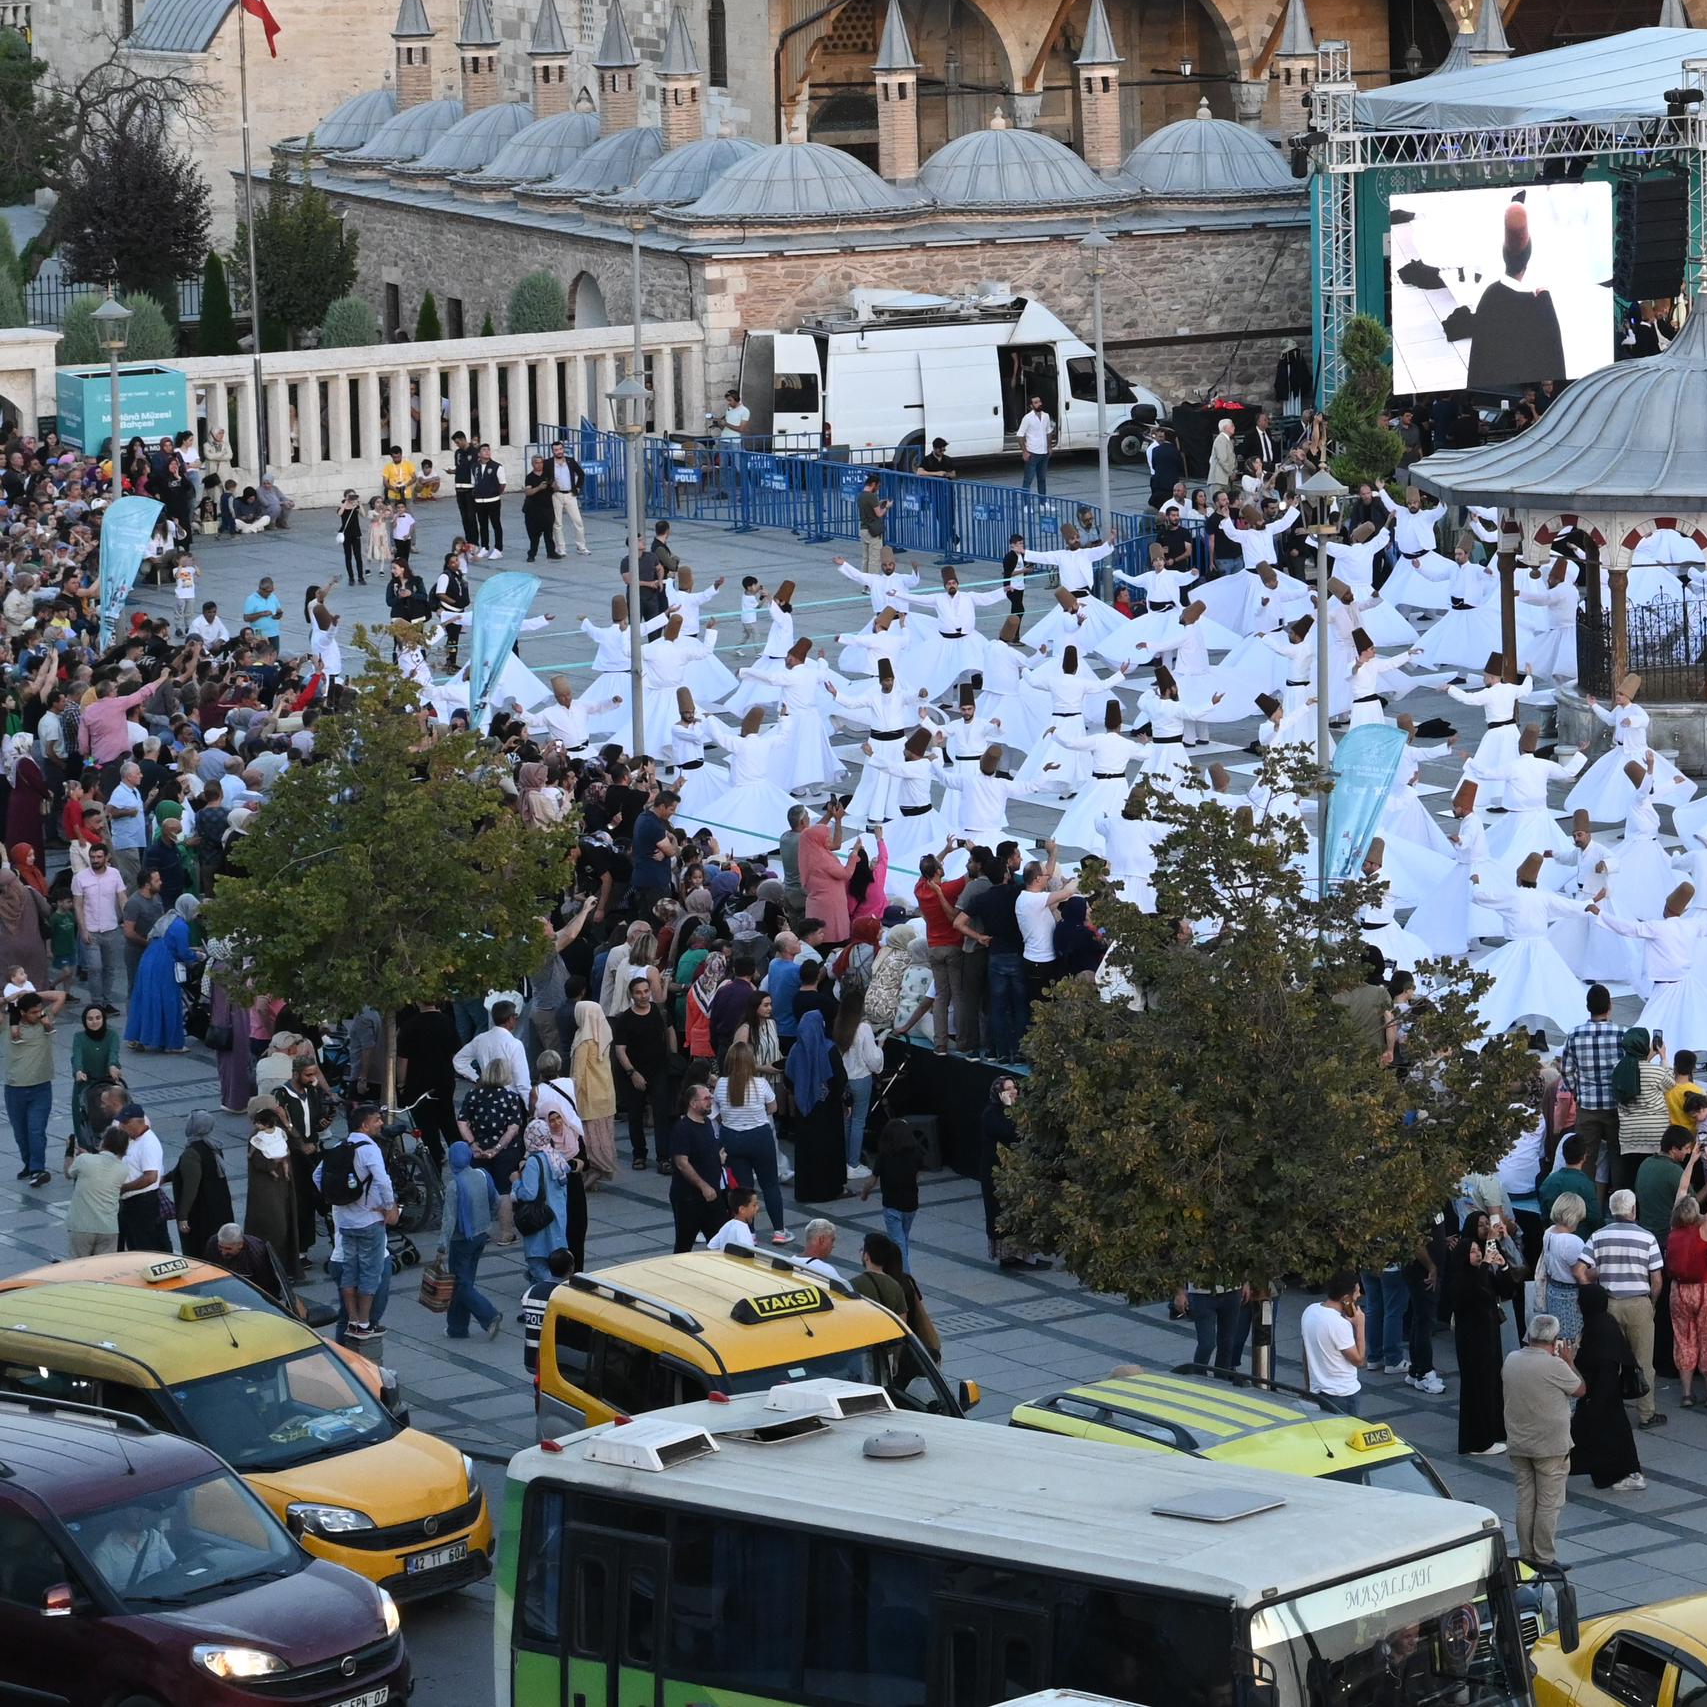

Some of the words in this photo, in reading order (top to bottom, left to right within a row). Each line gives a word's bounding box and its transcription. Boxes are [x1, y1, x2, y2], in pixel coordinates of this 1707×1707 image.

[584, 465, 603, 475] OLİS
[674, 474, 698, 483] POLİS
[758, 1289, 815, 1311] TAKSİ
[525, 1313, 544, 1326] POL
[1345, 1564, 1432, 1610] MAŞALLAH
